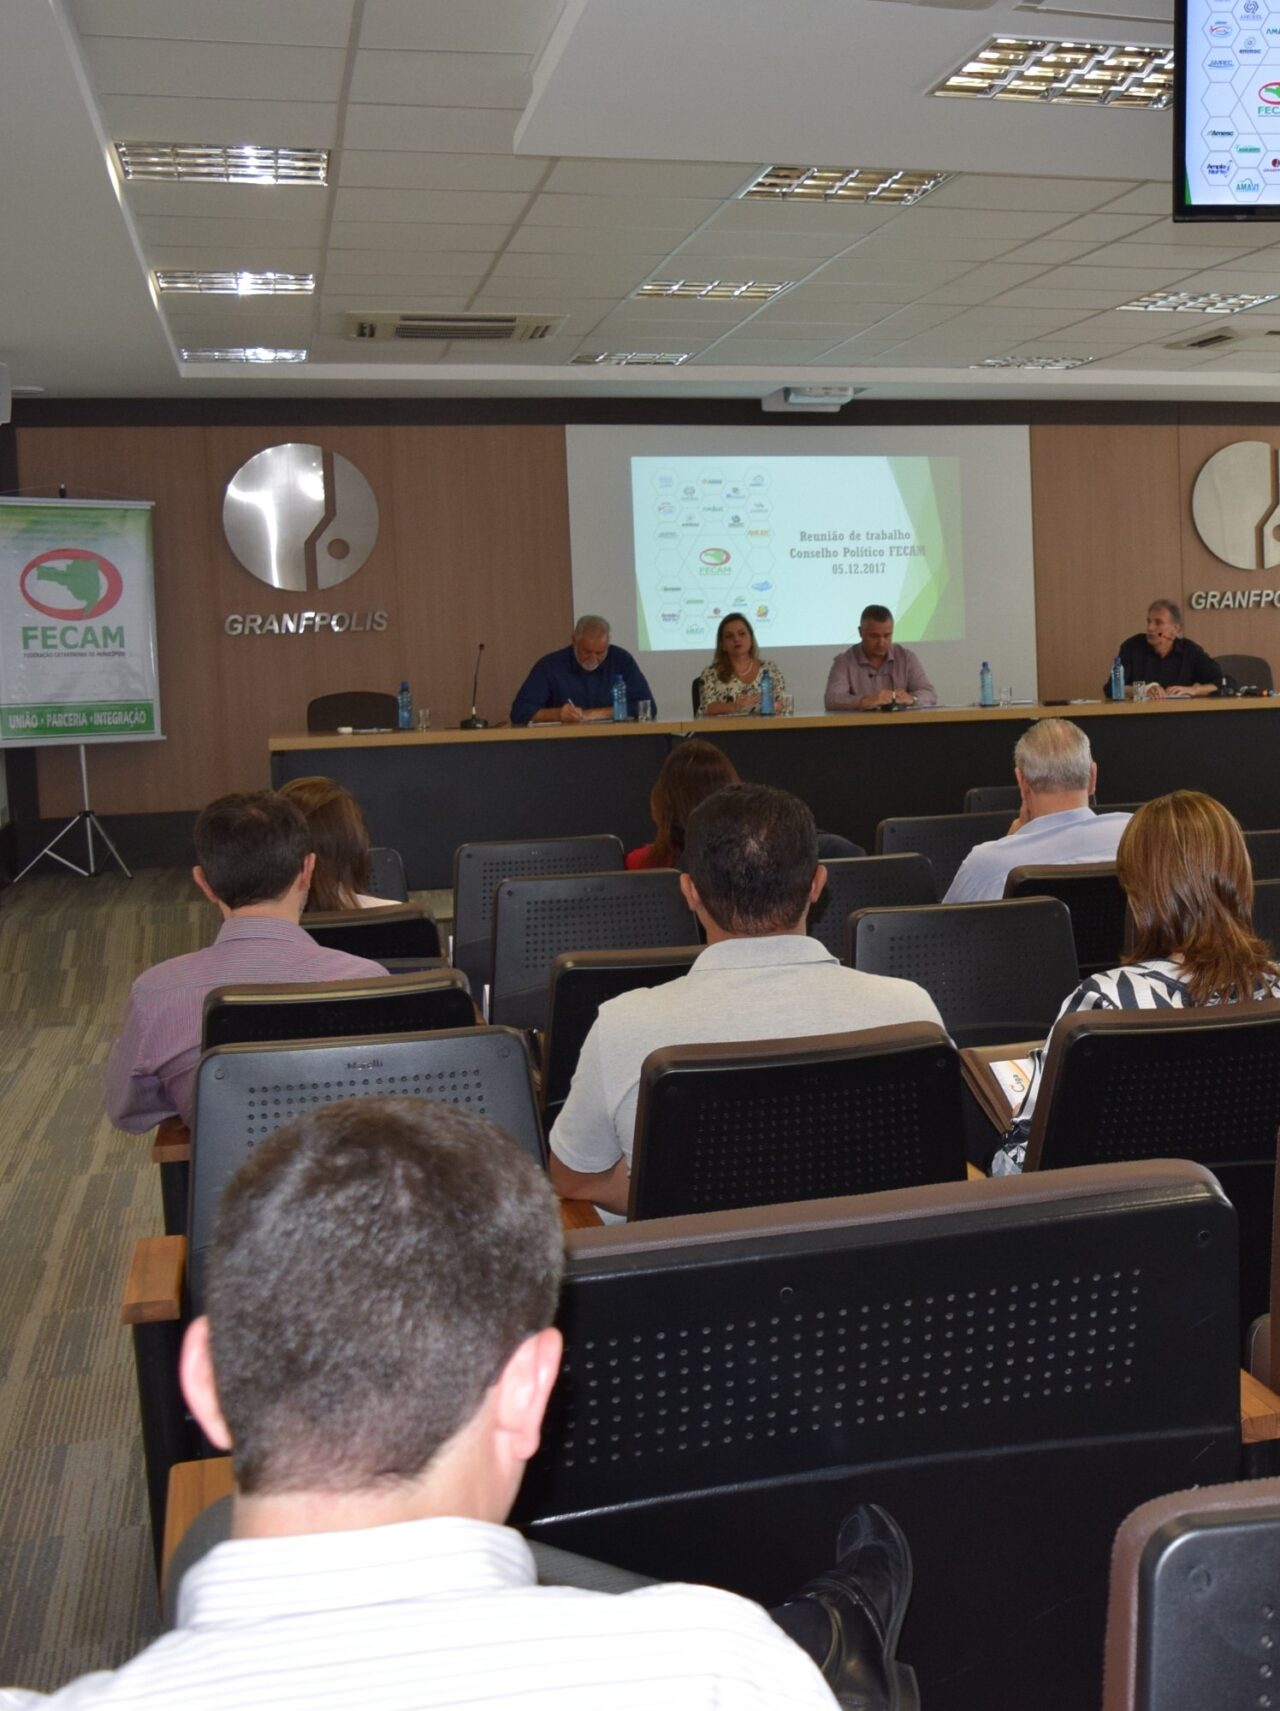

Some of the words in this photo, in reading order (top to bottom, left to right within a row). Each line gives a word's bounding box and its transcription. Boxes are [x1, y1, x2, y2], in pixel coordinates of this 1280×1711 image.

[799, 530, 845, 542] Reunião
[849, 529, 862, 541] de
[866, 529, 911, 541] trabalho
[789, 547, 839, 559] Conselho
[843, 546, 885, 558] Político
[889, 545, 926, 557] FECAM
[832, 562, 886, 575] 05.12.2017
[224, 611, 389, 636] GRANFPOLIS
[21, 625, 125, 650] FECAM
[8, 711, 39, 729] UNIÃO
[46, 711, 88, 728] PARCERIA
[93, 708, 146, 728] INTEGRAÇÃO
